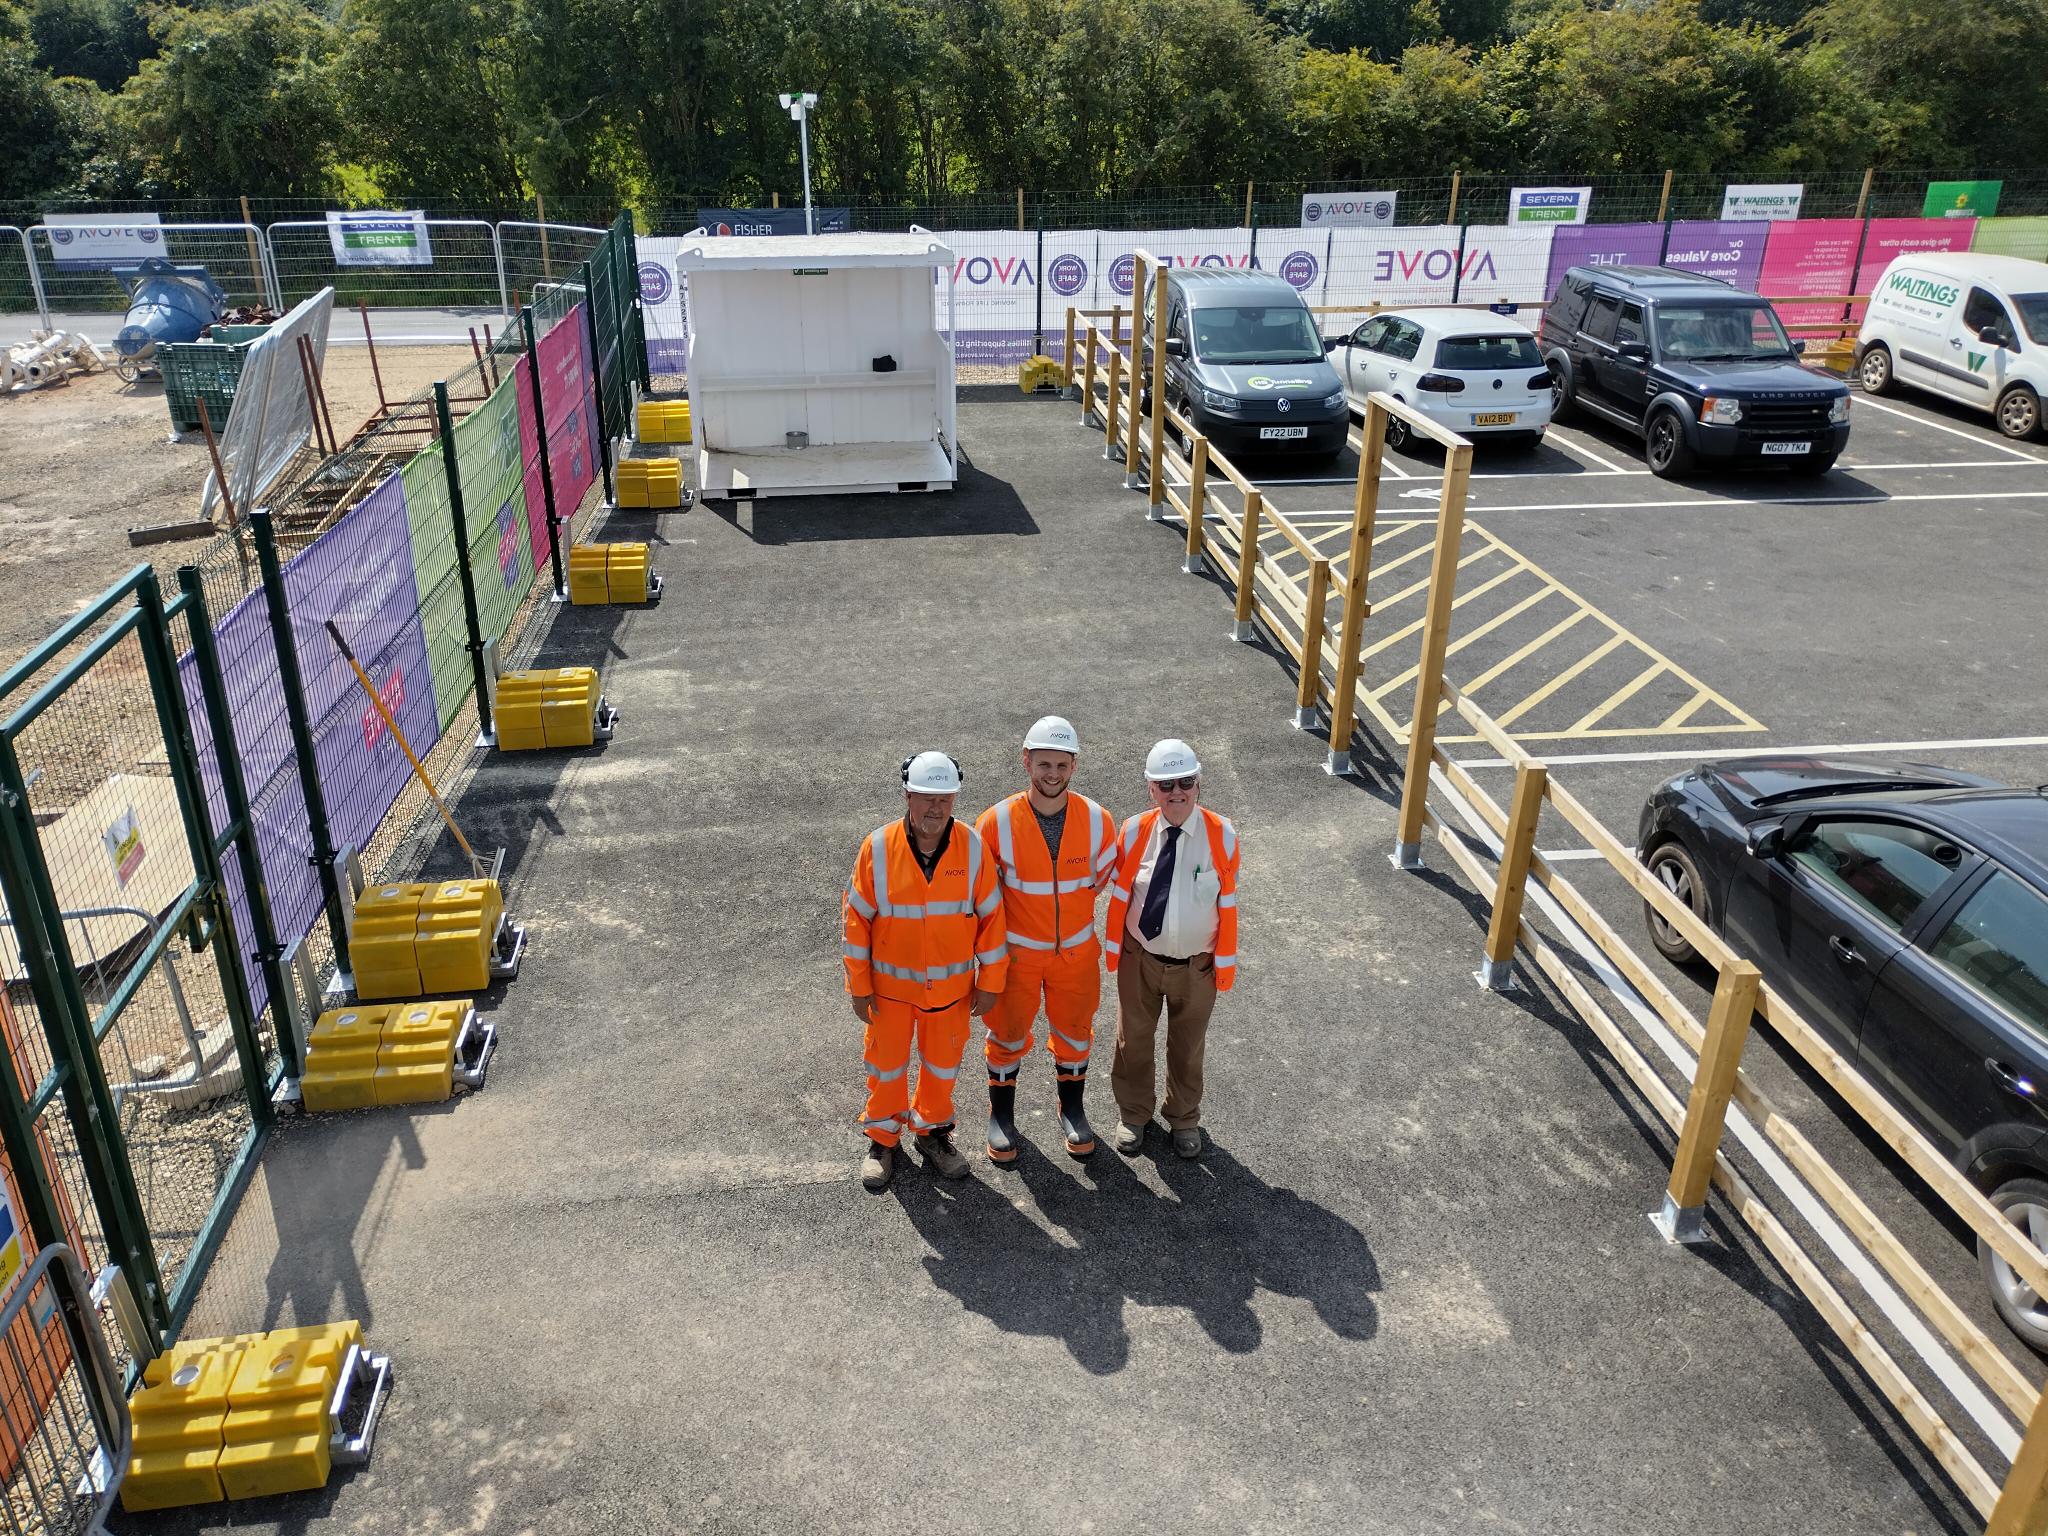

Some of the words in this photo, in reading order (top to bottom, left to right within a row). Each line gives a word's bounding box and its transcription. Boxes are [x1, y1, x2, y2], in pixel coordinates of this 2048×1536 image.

[1526, 195, 1574, 204] SEVERN
[1743, 196, 1784, 205] WAITINGS
[1326, 202, 1373, 215] AVOVE
[1529, 210, 1568, 219] TRENT
[734, 224, 773, 236] FISHER
[360, 235, 403, 245] TRENT
[1890, 274, 1960, 305] WAITINGS
[1263, 428, 1285, 437] FY22
[1287, 428, 1304, 437] UBN
[1765, 443, 1790, 452] NG07
[1791, 443, 1807, 452] TKA
[1163, 759, 1184, 768] AVOVE
[1066, 856, 1088, 865] AVOVE
[944, 869, 966, 877] AVOVE
